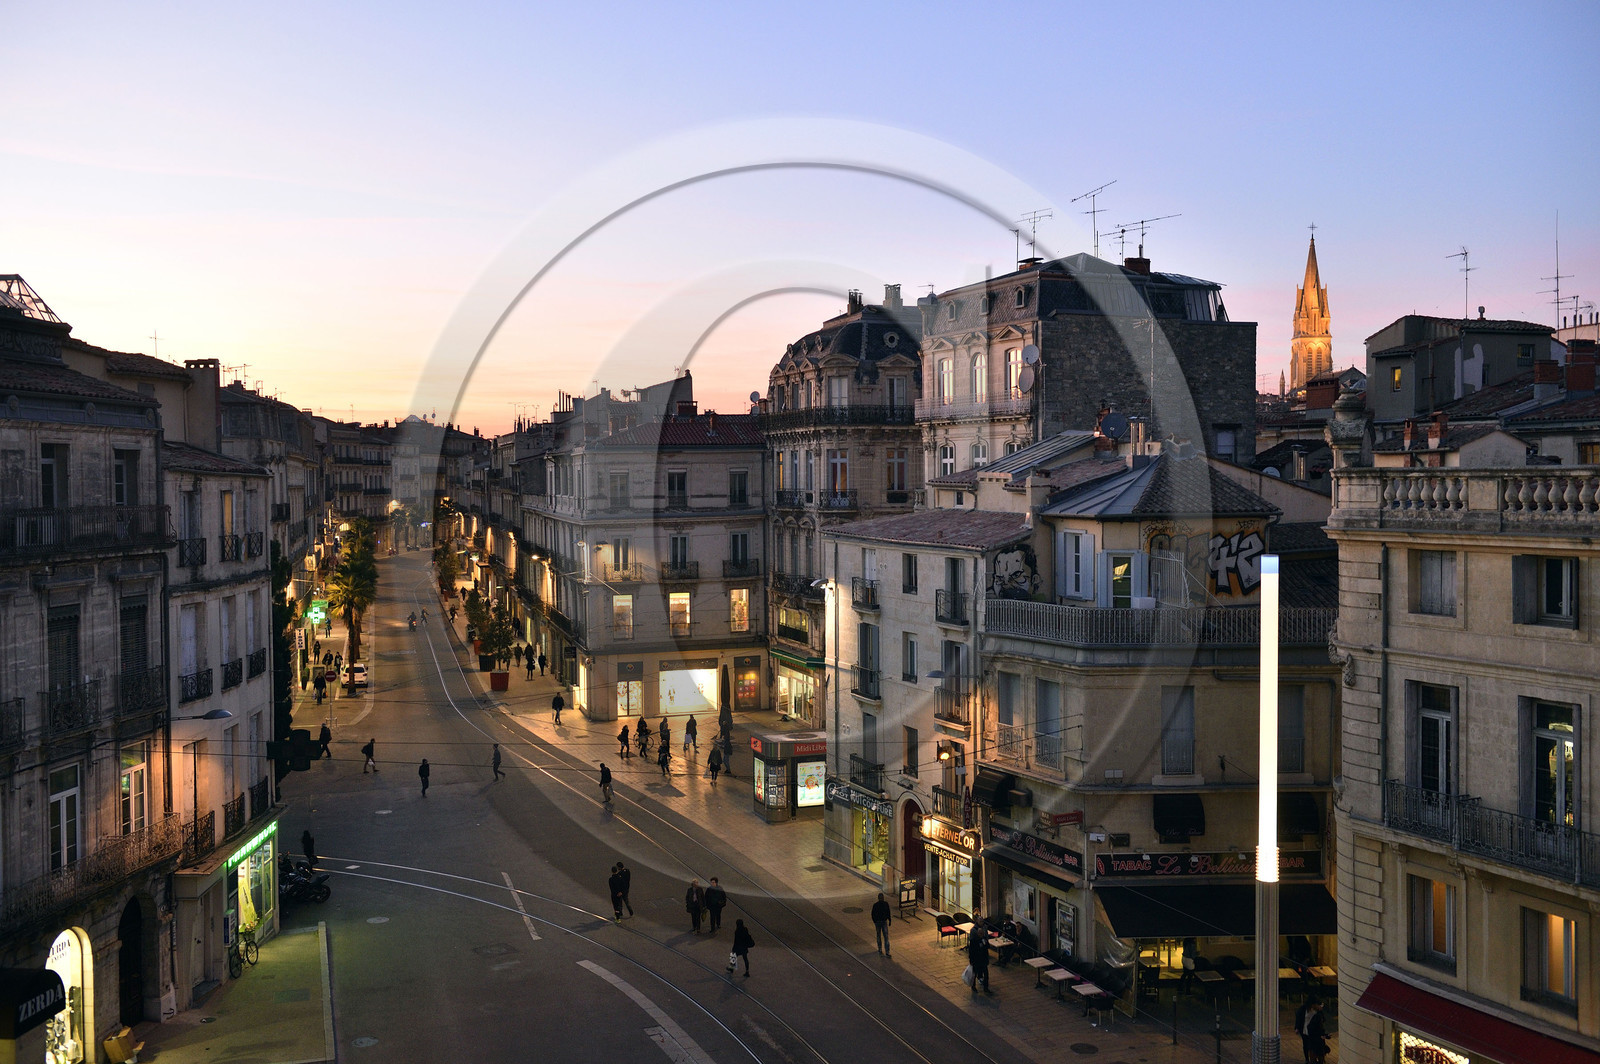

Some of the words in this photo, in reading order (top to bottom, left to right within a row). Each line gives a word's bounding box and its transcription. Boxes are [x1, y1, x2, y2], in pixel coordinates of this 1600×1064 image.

[862, 798, 893, 818] COIFURE
[932, 825, 963, 846] ETERNEL
[963, 835, 976, 851] OR
[1064, 853, 1079, 866] BAR
[1112, 860, 1152, 871] TABAC
[1155, 855, 1182, 875] Le
[1188, 854, 1257, 874] Bellissi
[1280, 857, 1305, 868] BAR
[19, 983, 64, 1021] ZERDA
